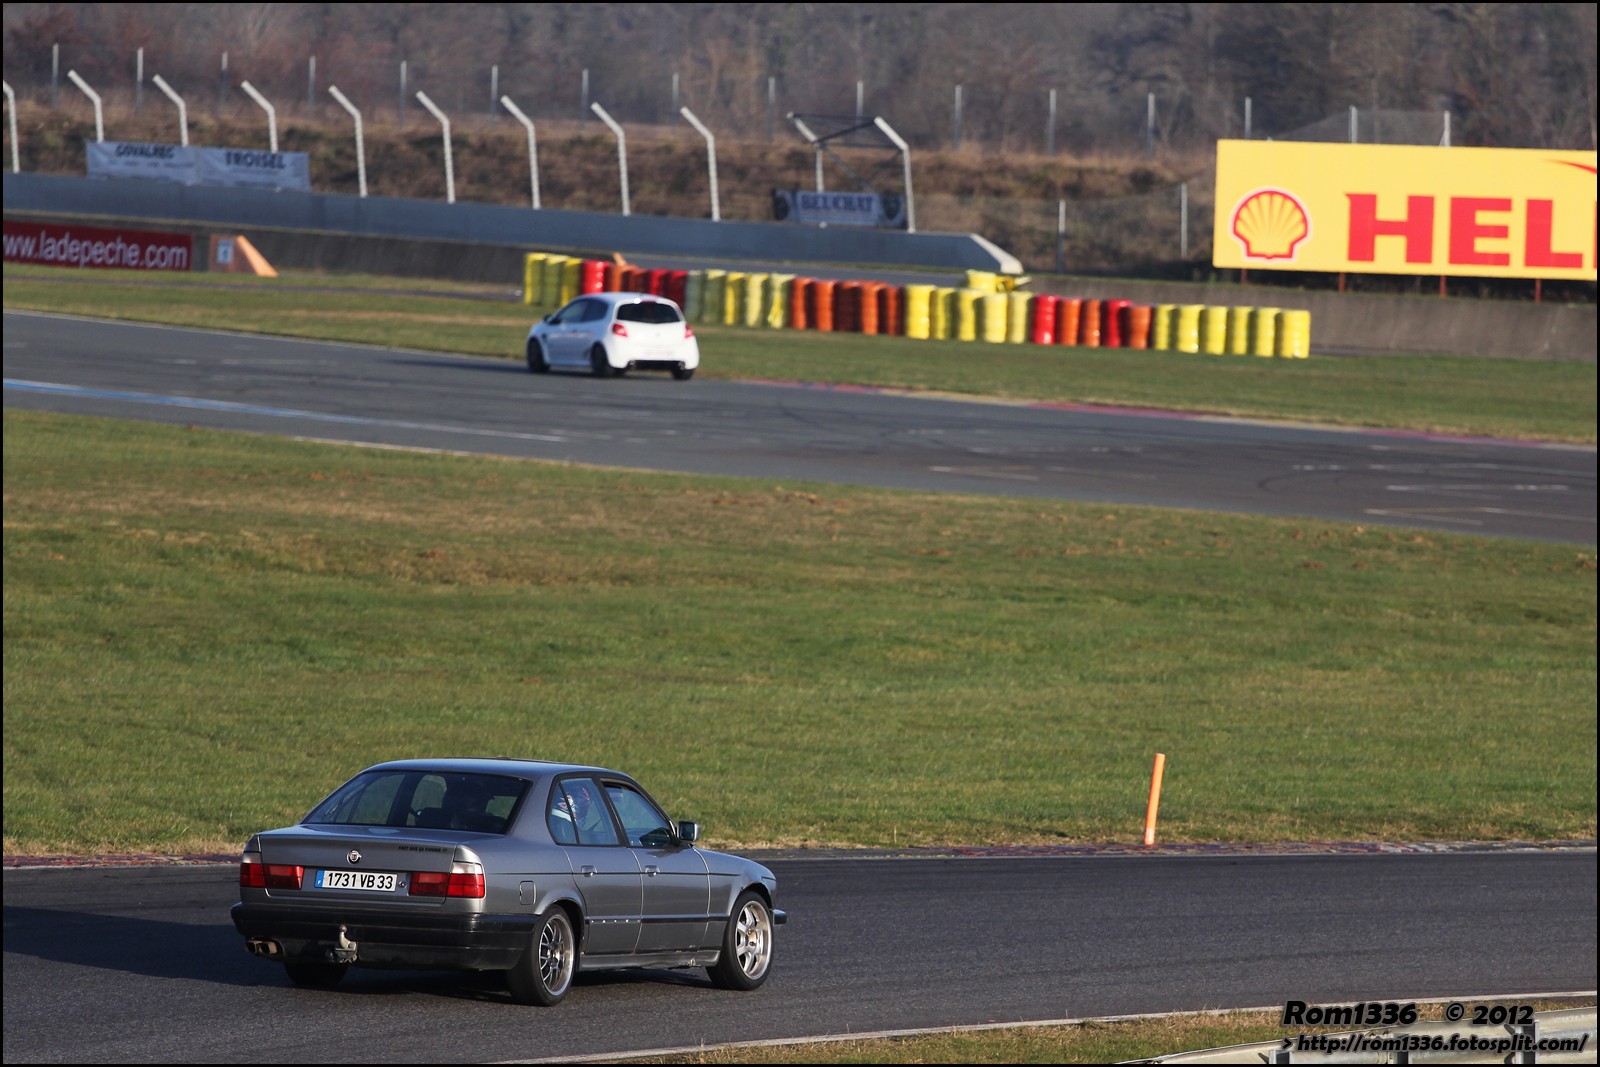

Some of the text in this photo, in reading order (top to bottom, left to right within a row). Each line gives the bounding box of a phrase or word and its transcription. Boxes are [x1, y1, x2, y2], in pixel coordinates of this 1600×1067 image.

[1345, 192, 1597, 269] HEL
[328, 872, 394, 890] 1731 VB 33
